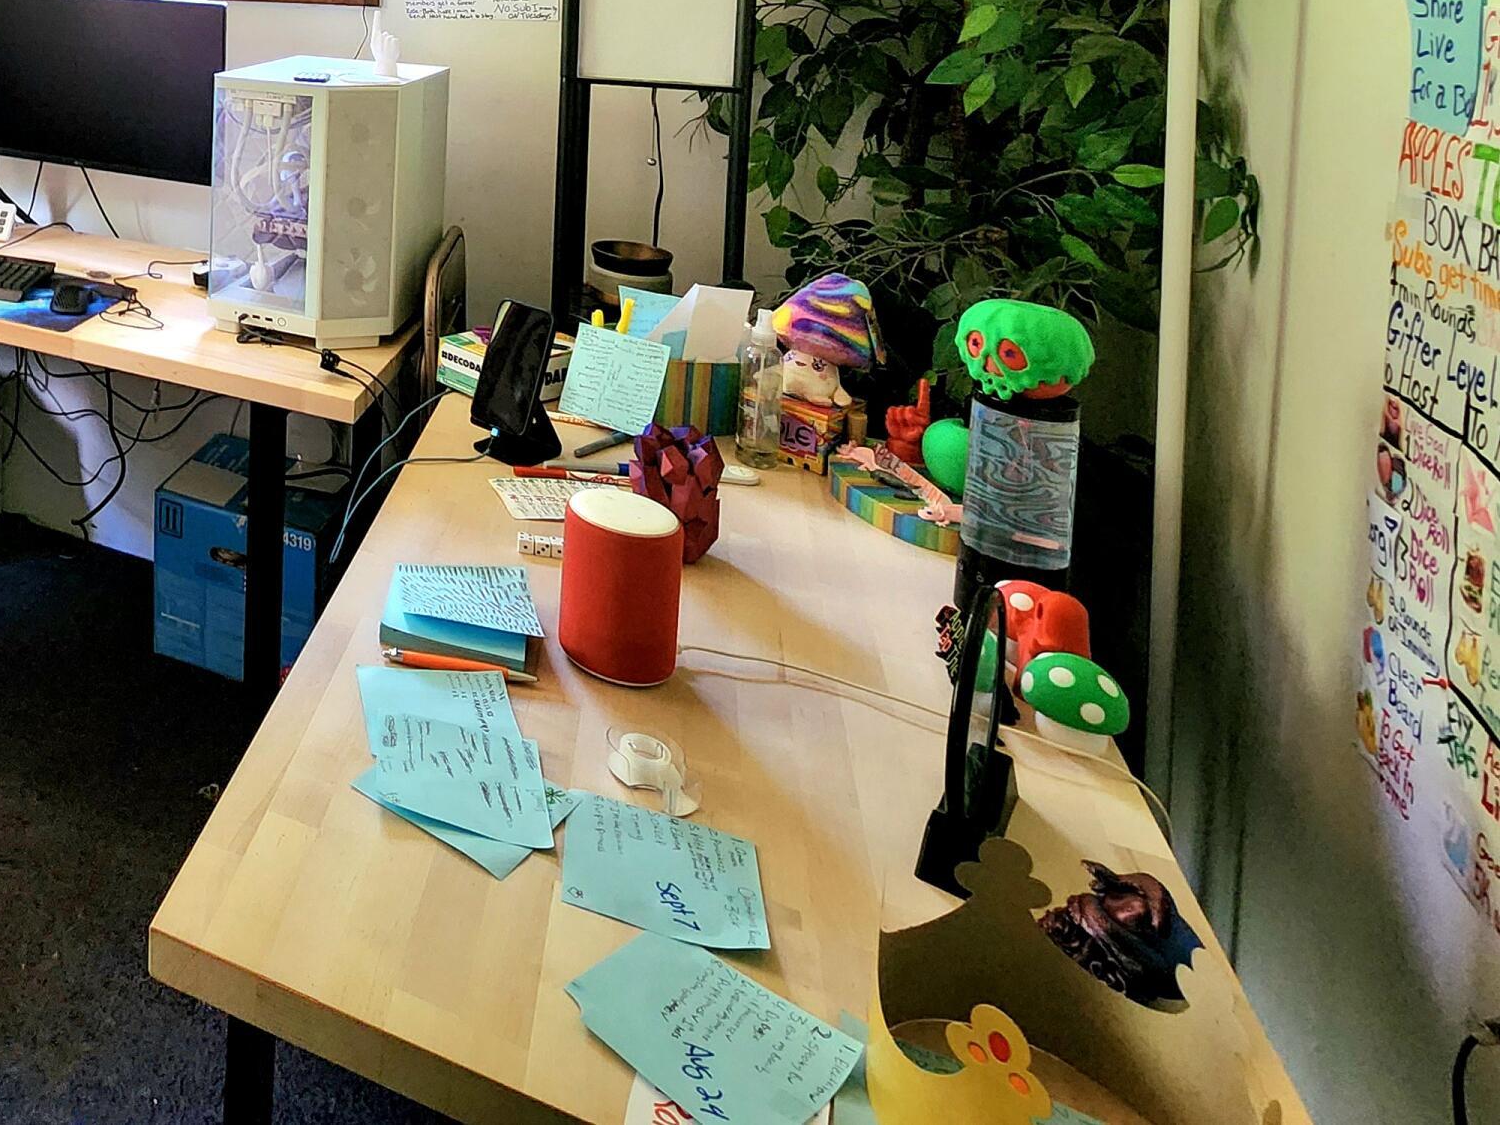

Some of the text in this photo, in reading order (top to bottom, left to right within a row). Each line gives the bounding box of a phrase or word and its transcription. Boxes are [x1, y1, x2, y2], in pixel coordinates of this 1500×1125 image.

[1416, 29, 1456, 63] Live
[1411, 67, 1433, 105] for
[1435, 84, 1447, 110] a
[1398, 120, 1473, 202] APPLES
[1392, 219, 1433, 279] Subs
[1439, 262, 1467, 300] get
[1425, 197, 1471, 267] BOX
[1386, 300, 1442, 371] Gifter
[1447, 330, 1498, 410] Level
[1399, 359, 1440, 418] Host
[1409, 525, 1441, 576] Dice
[1388, 678, 1425, 745] Board
[655, 881, 697, 917] Sept
